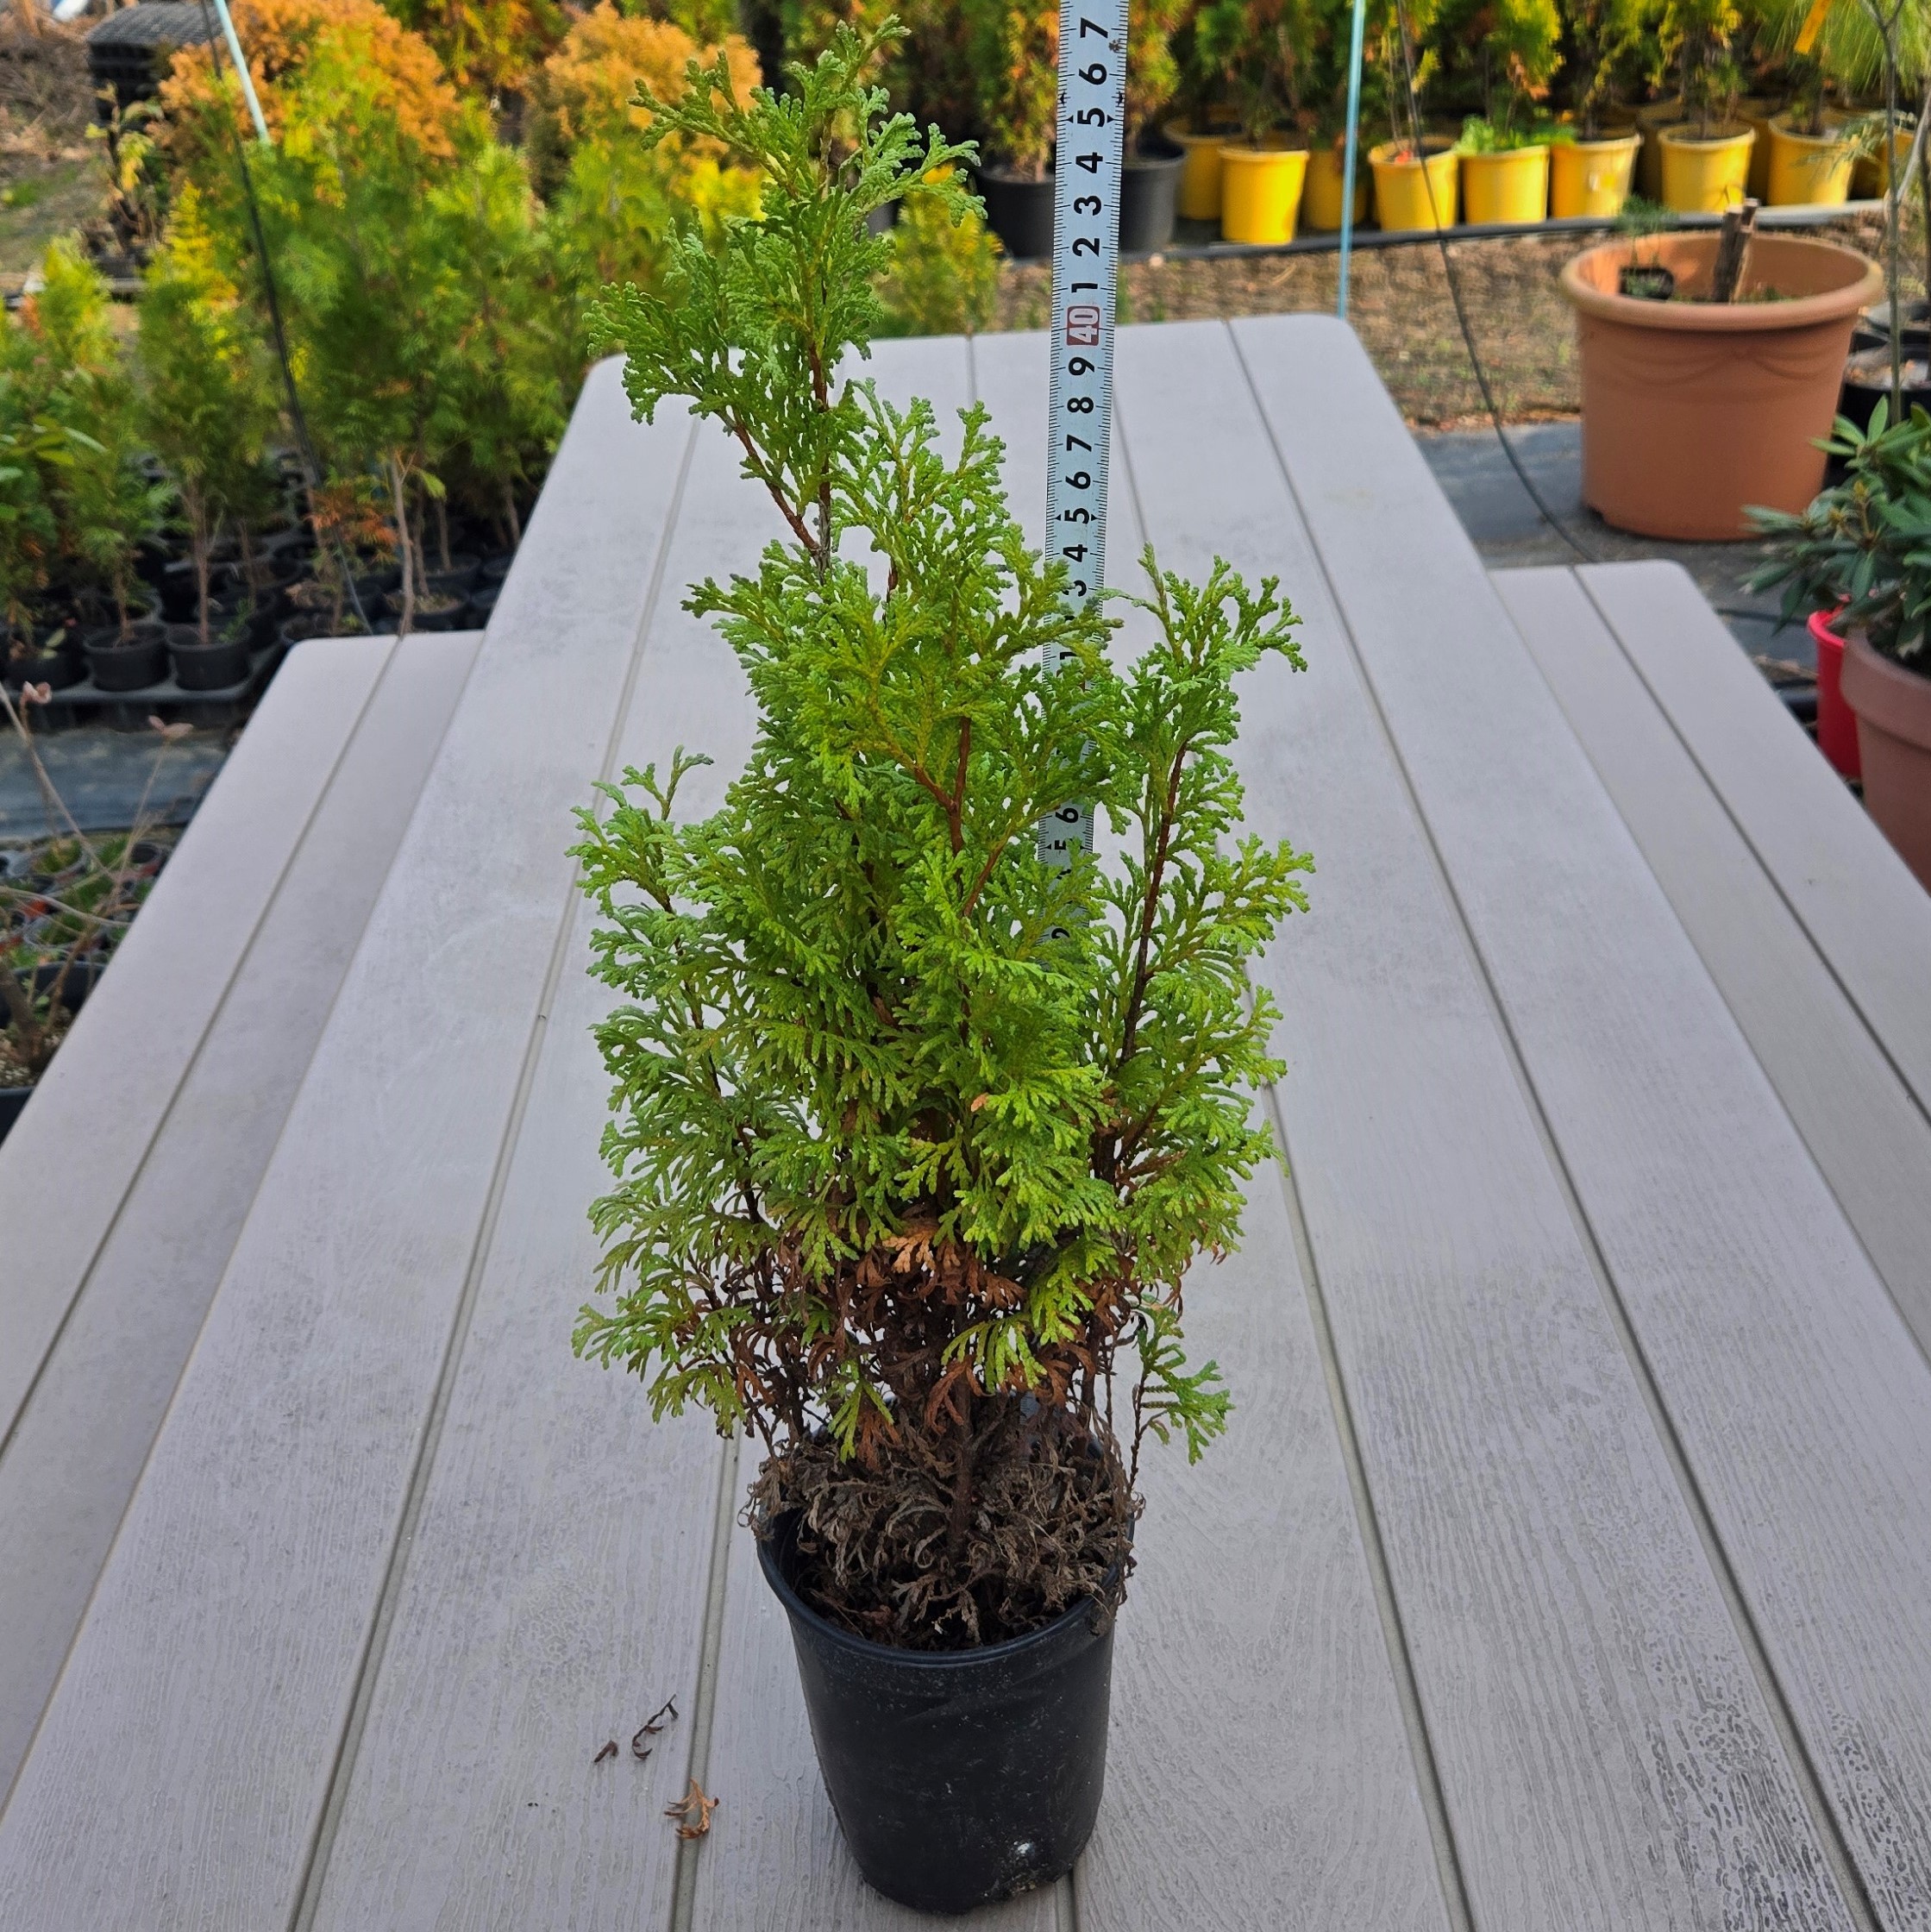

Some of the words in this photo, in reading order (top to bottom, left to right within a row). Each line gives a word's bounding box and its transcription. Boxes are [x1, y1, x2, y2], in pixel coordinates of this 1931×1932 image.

[1080, 17, 1108, 39] 7
[1079, 63, 1107, 85] 6
[1077, 108, 1105, 128] 5
[1075, 152, 1103, 173] 4
[1074, 195, 1102, 216] 3
[1072, 237, 1100, 257] 2
[1071, 283, 1098, 293] 1
[1068, 307, 1100, 345] 40
[1068, 356, 1095, 376] 9
[1067, 397, 1094, 414] 8
[1066, 434, 1092, 452] 7
[1065, 471, 1091, 490] 6
[1064, 508, 1089, 524] 5
[1063, 544, 1088, 562] 4
[1055, 807, 1078, 824] 6
